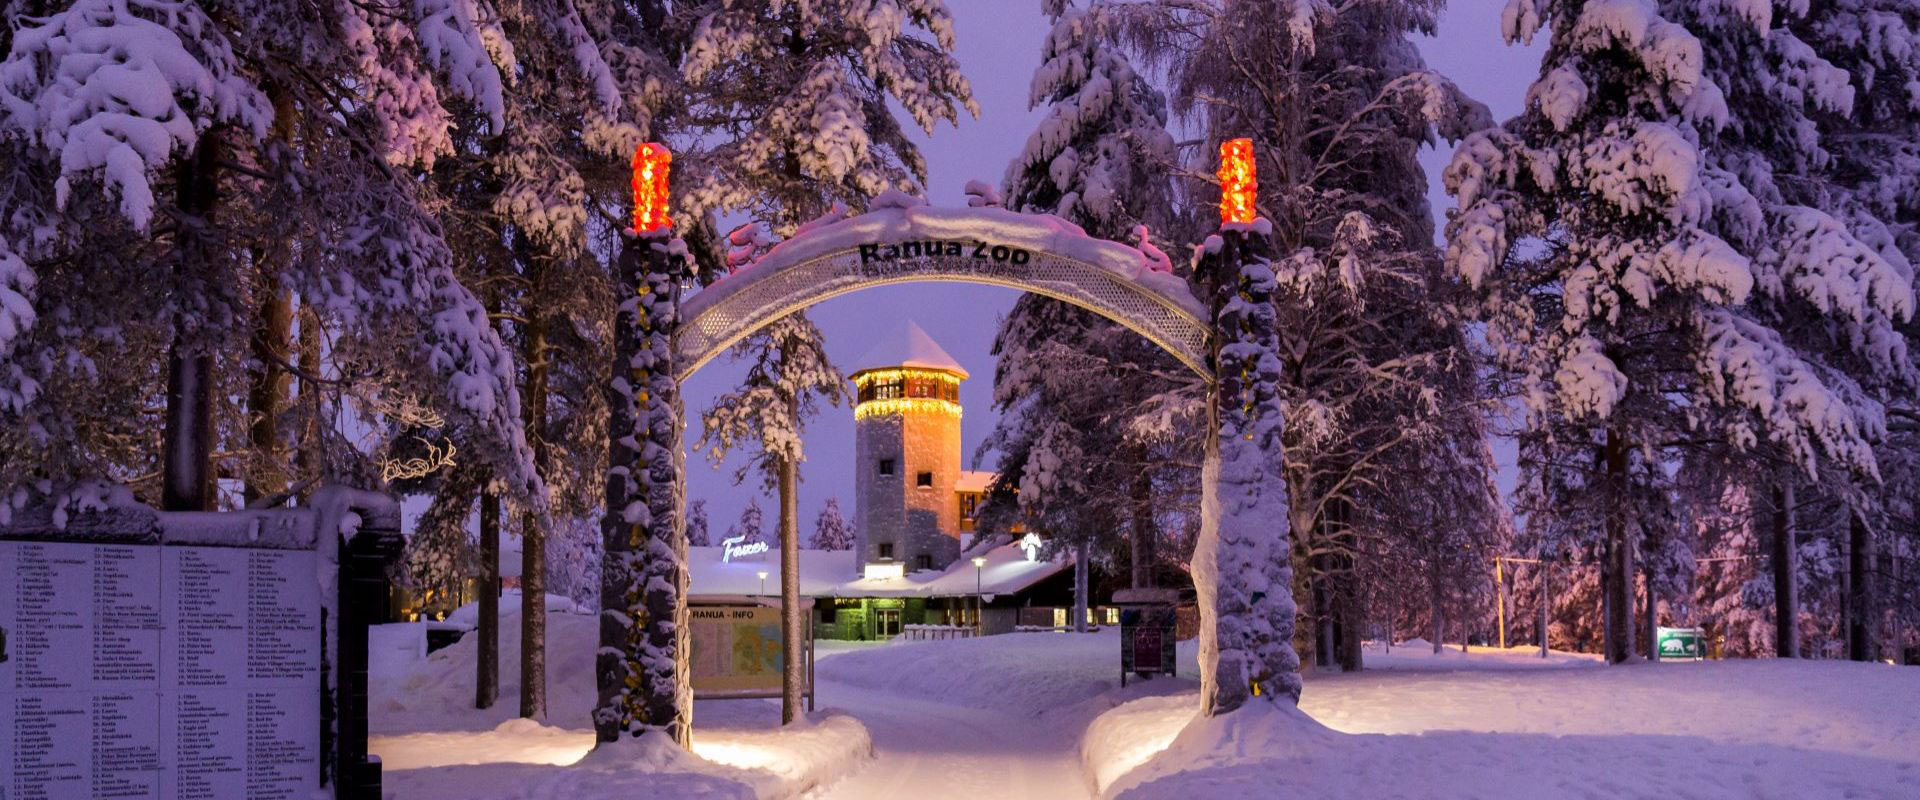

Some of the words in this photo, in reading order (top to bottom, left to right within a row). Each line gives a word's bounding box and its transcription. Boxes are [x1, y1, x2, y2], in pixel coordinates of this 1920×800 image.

[859, 240, 963, 263] Ranua
[972, 240, 1030, 265] Zoo
[692, 611, 725, 619] RANUA
[732, 611, 754, 619] INFO
